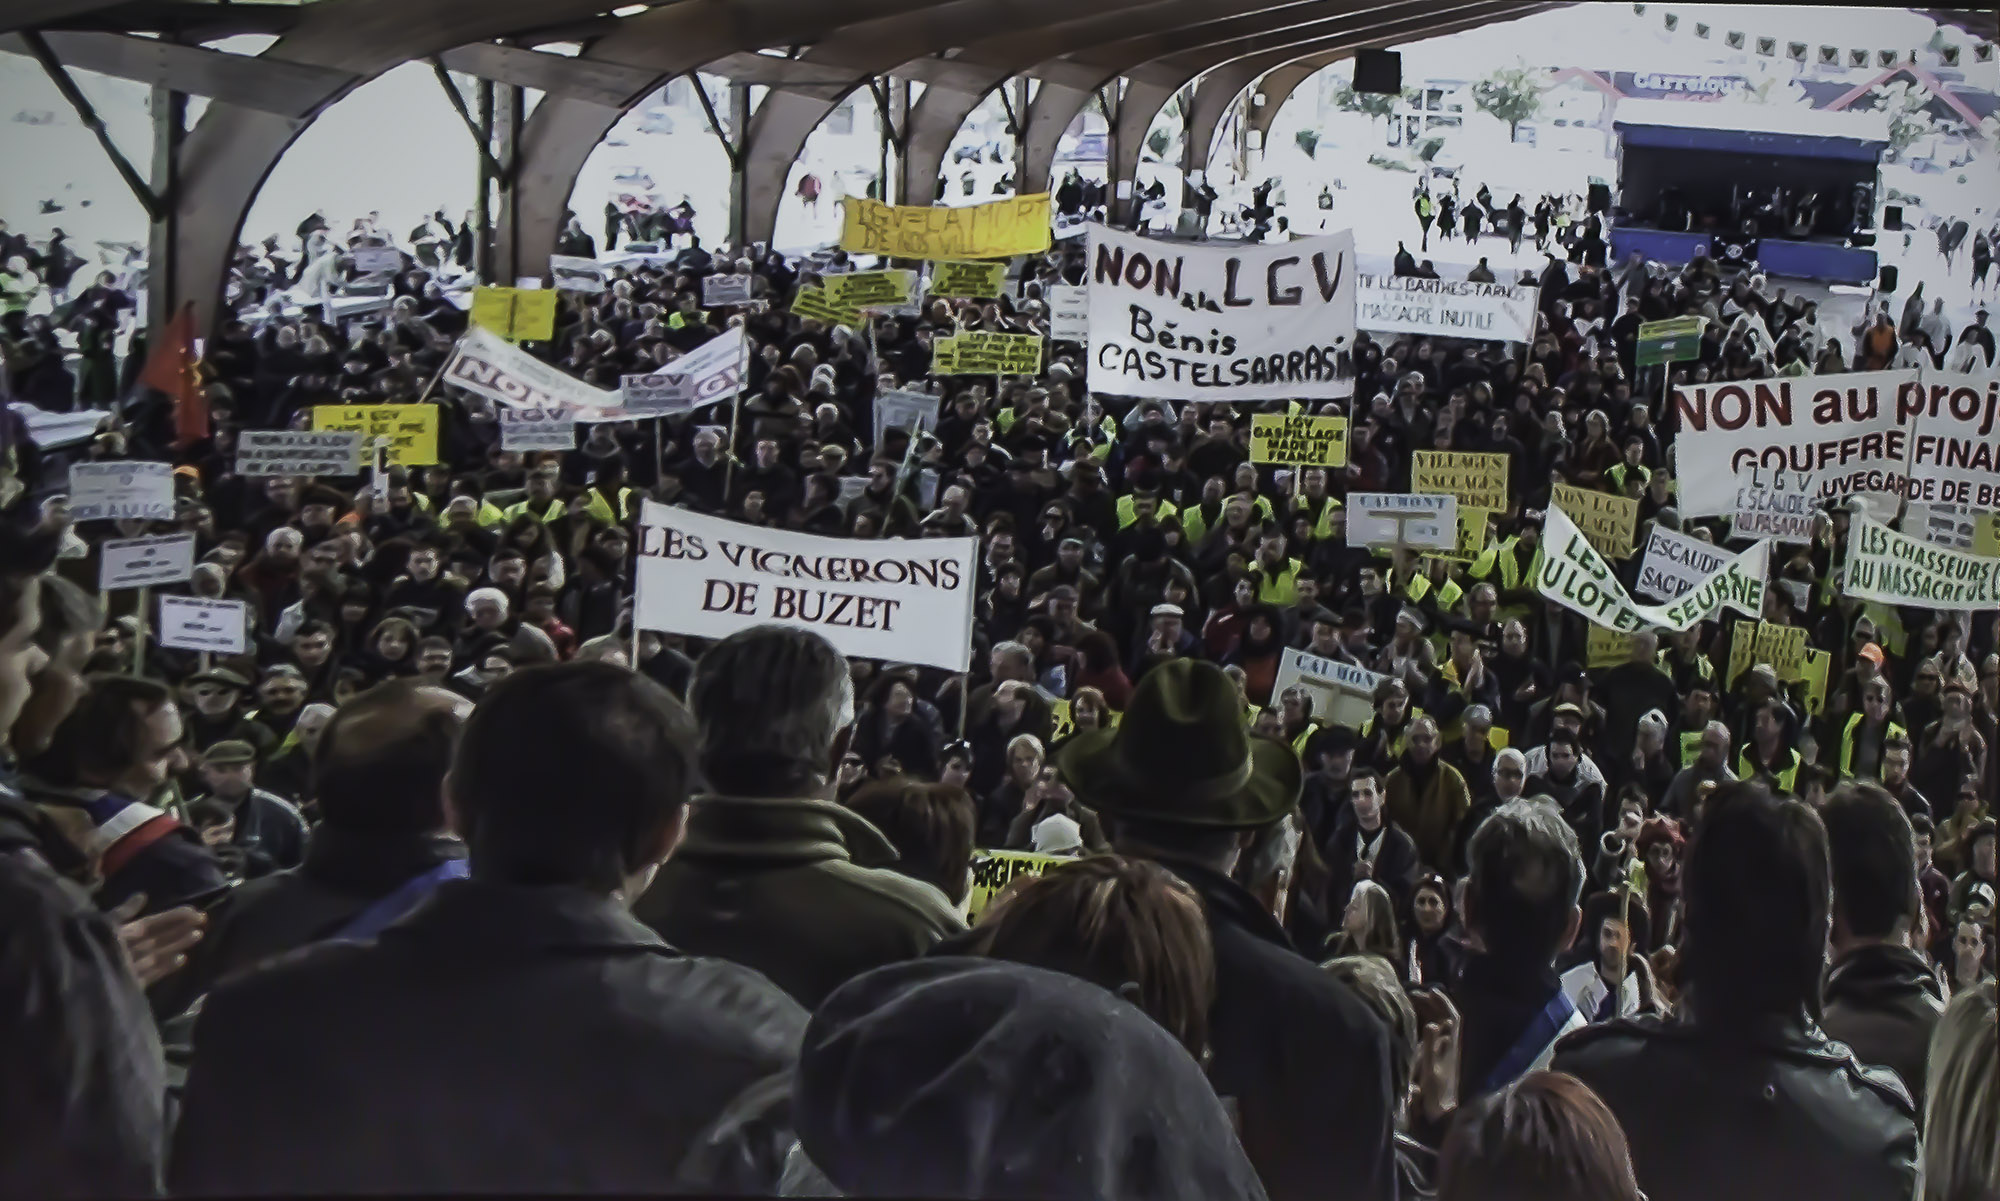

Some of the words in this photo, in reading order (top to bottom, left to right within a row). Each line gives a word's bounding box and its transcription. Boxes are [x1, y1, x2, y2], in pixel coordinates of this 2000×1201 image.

[1095, 243, 1183, 299] NON
[1223, 250, 1344, 306] LGV
[1362, 303, 1433, 325] MASSACRE
[1440, 308, 1494, 330] INUTILE
[627, 374, 686, 388] LGV
[506, 408, 565, 422] LGV
[1674, 382, 1792, 431] NON
[1812, 386, 1878, 425] au
[1896, 381, 2000, 436] proj
[1253, 426, 1344, 440] GASPILLAGE
[1284, 416, 1314, 428] LGV
[1267, 439, 1308, 450] MADE
[1268, 450, 1328, 464] FRANCE
[1731, 430, 1905, 474] GOUFFRE
[1915, 434, 2000, 472] FINA
[1416, 452, 1503, 469] VILLAGES
[1419, 474, 1503, 490] SACCAGES
[1752, 466, 1813, 492] LGV
[1817, 469, 1935, 500] UVEGARDE
[1941, 480, 1971, 503] DE
[1554, 487, 1585, 506] NON
[638, 524, 709, 561] LES
[717, 539, 960, 591] VIGNERONS
[1860, 522, 1888, 555] LES
[1892, 538, 1990, 582] CHASSEURS
[1848, 559, 1874, 589] AU
[701, 578, 759, 615] DE
[771, 586, 901, 631] BUZET
[1563, 569, 1616, 616] LOT
[1613, 606, 1651, 631] ET
[1295, 655, 1376, 688] CAUMON
